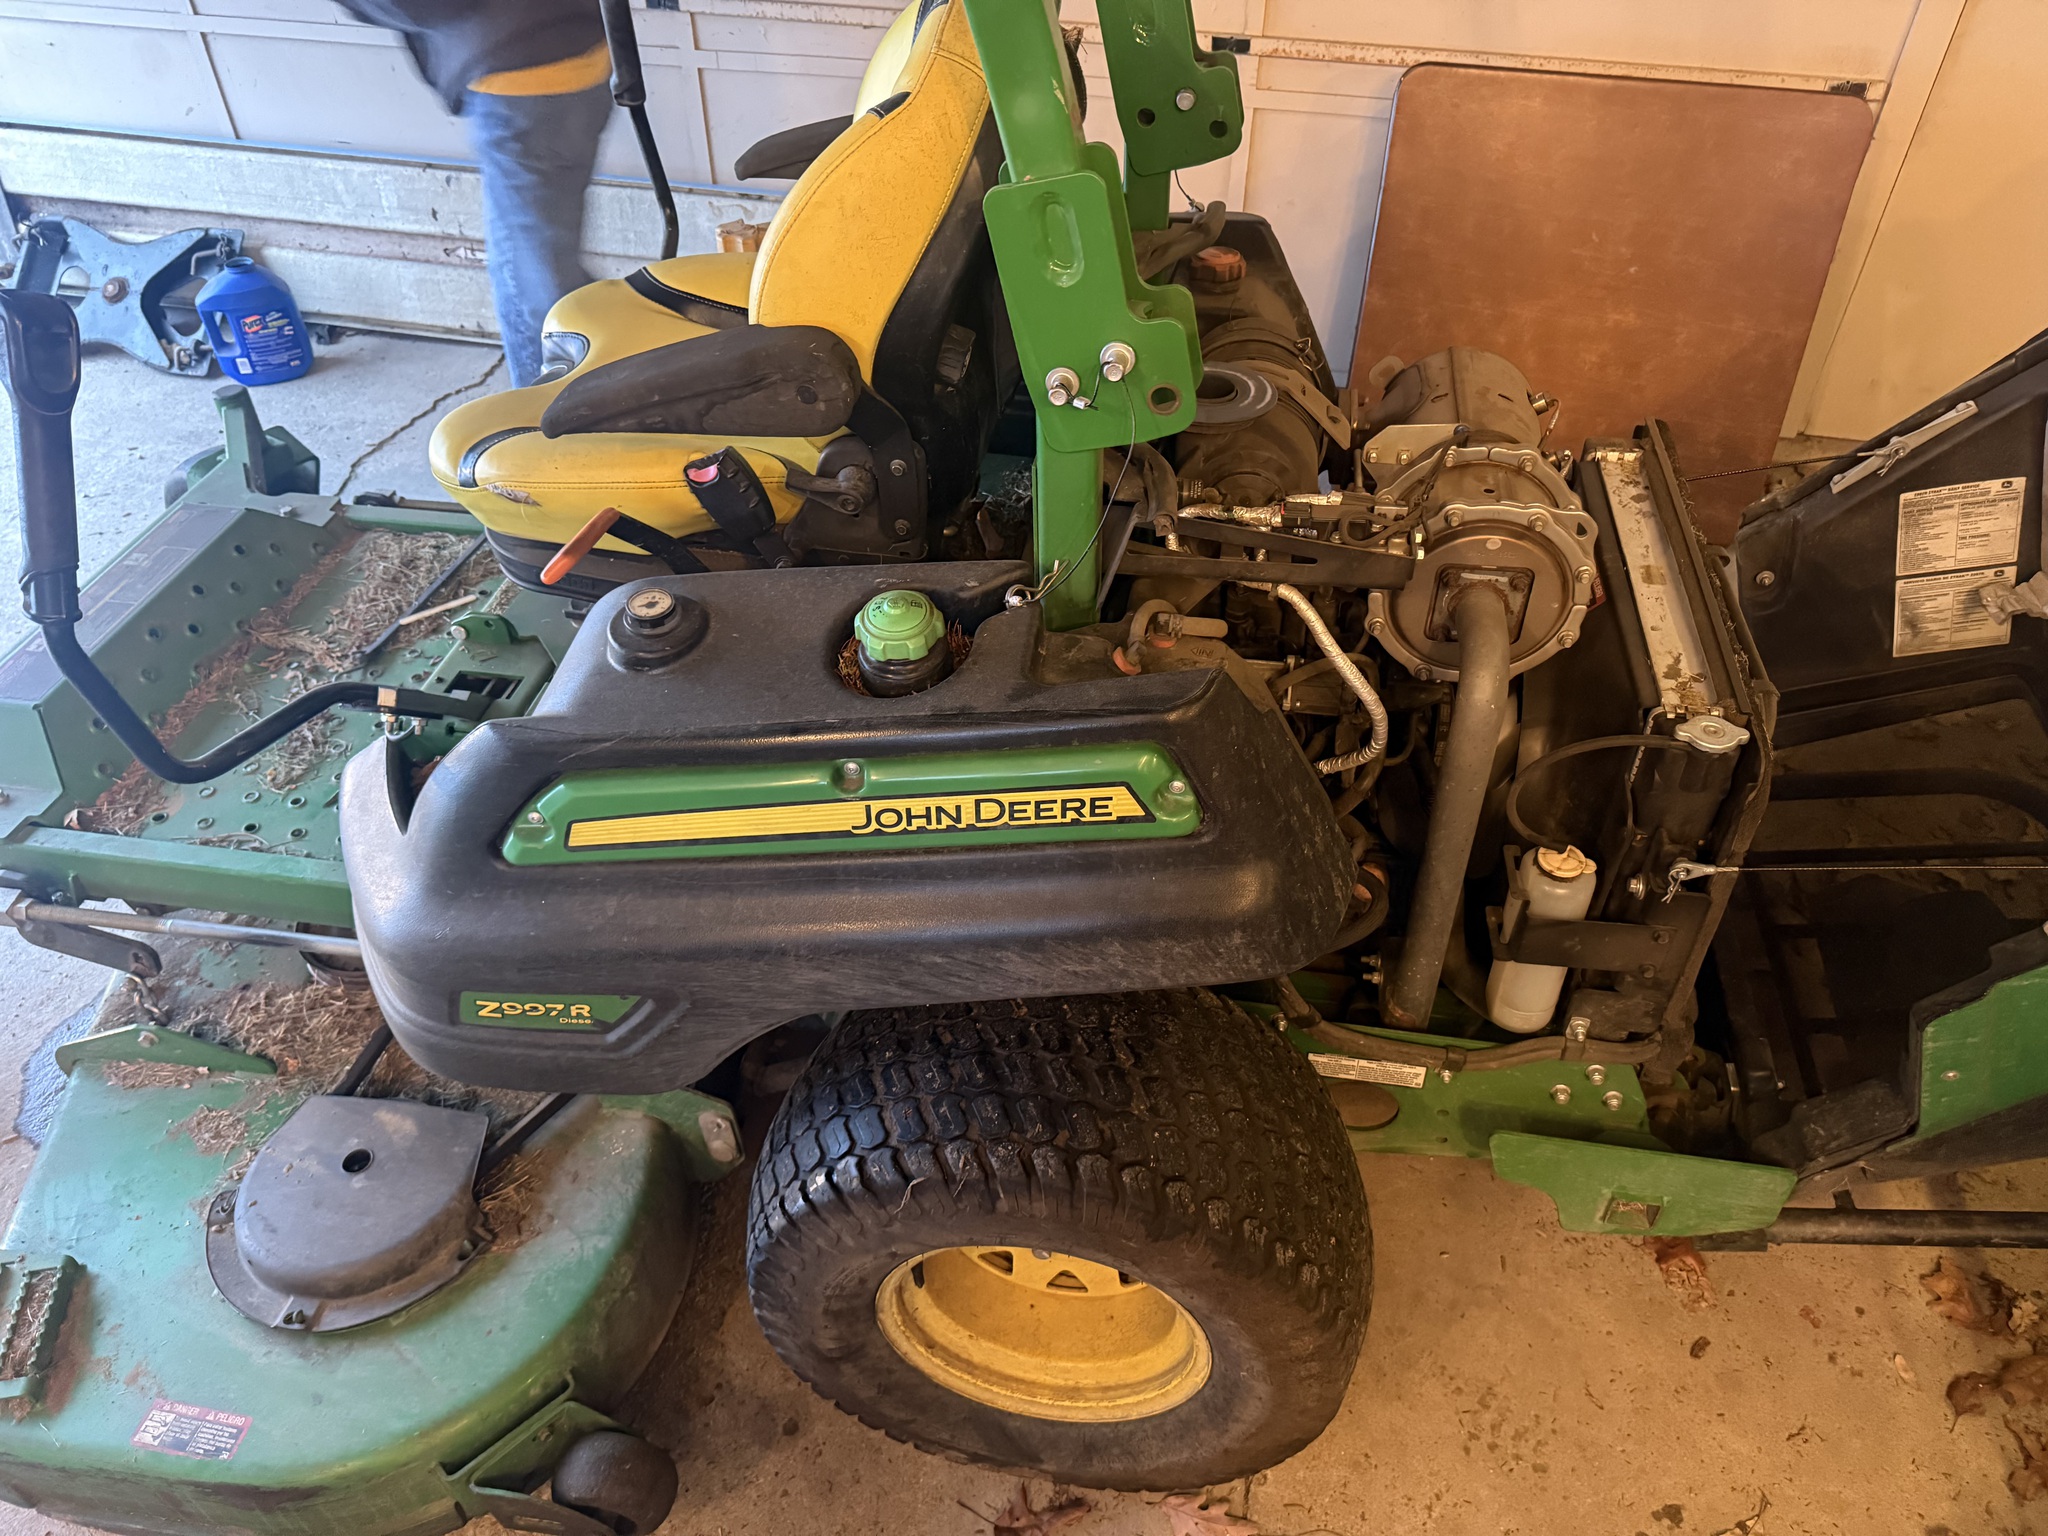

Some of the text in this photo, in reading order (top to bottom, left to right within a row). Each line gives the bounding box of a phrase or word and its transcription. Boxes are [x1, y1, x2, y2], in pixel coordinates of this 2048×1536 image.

[851, 796, 1114, 831] JOHN DEERE
[559, 1017, 594, 1025] Diese
[172, 1403, 200, 1416] DANGER
[215, 1412, 246, 1426] PELIGRO
